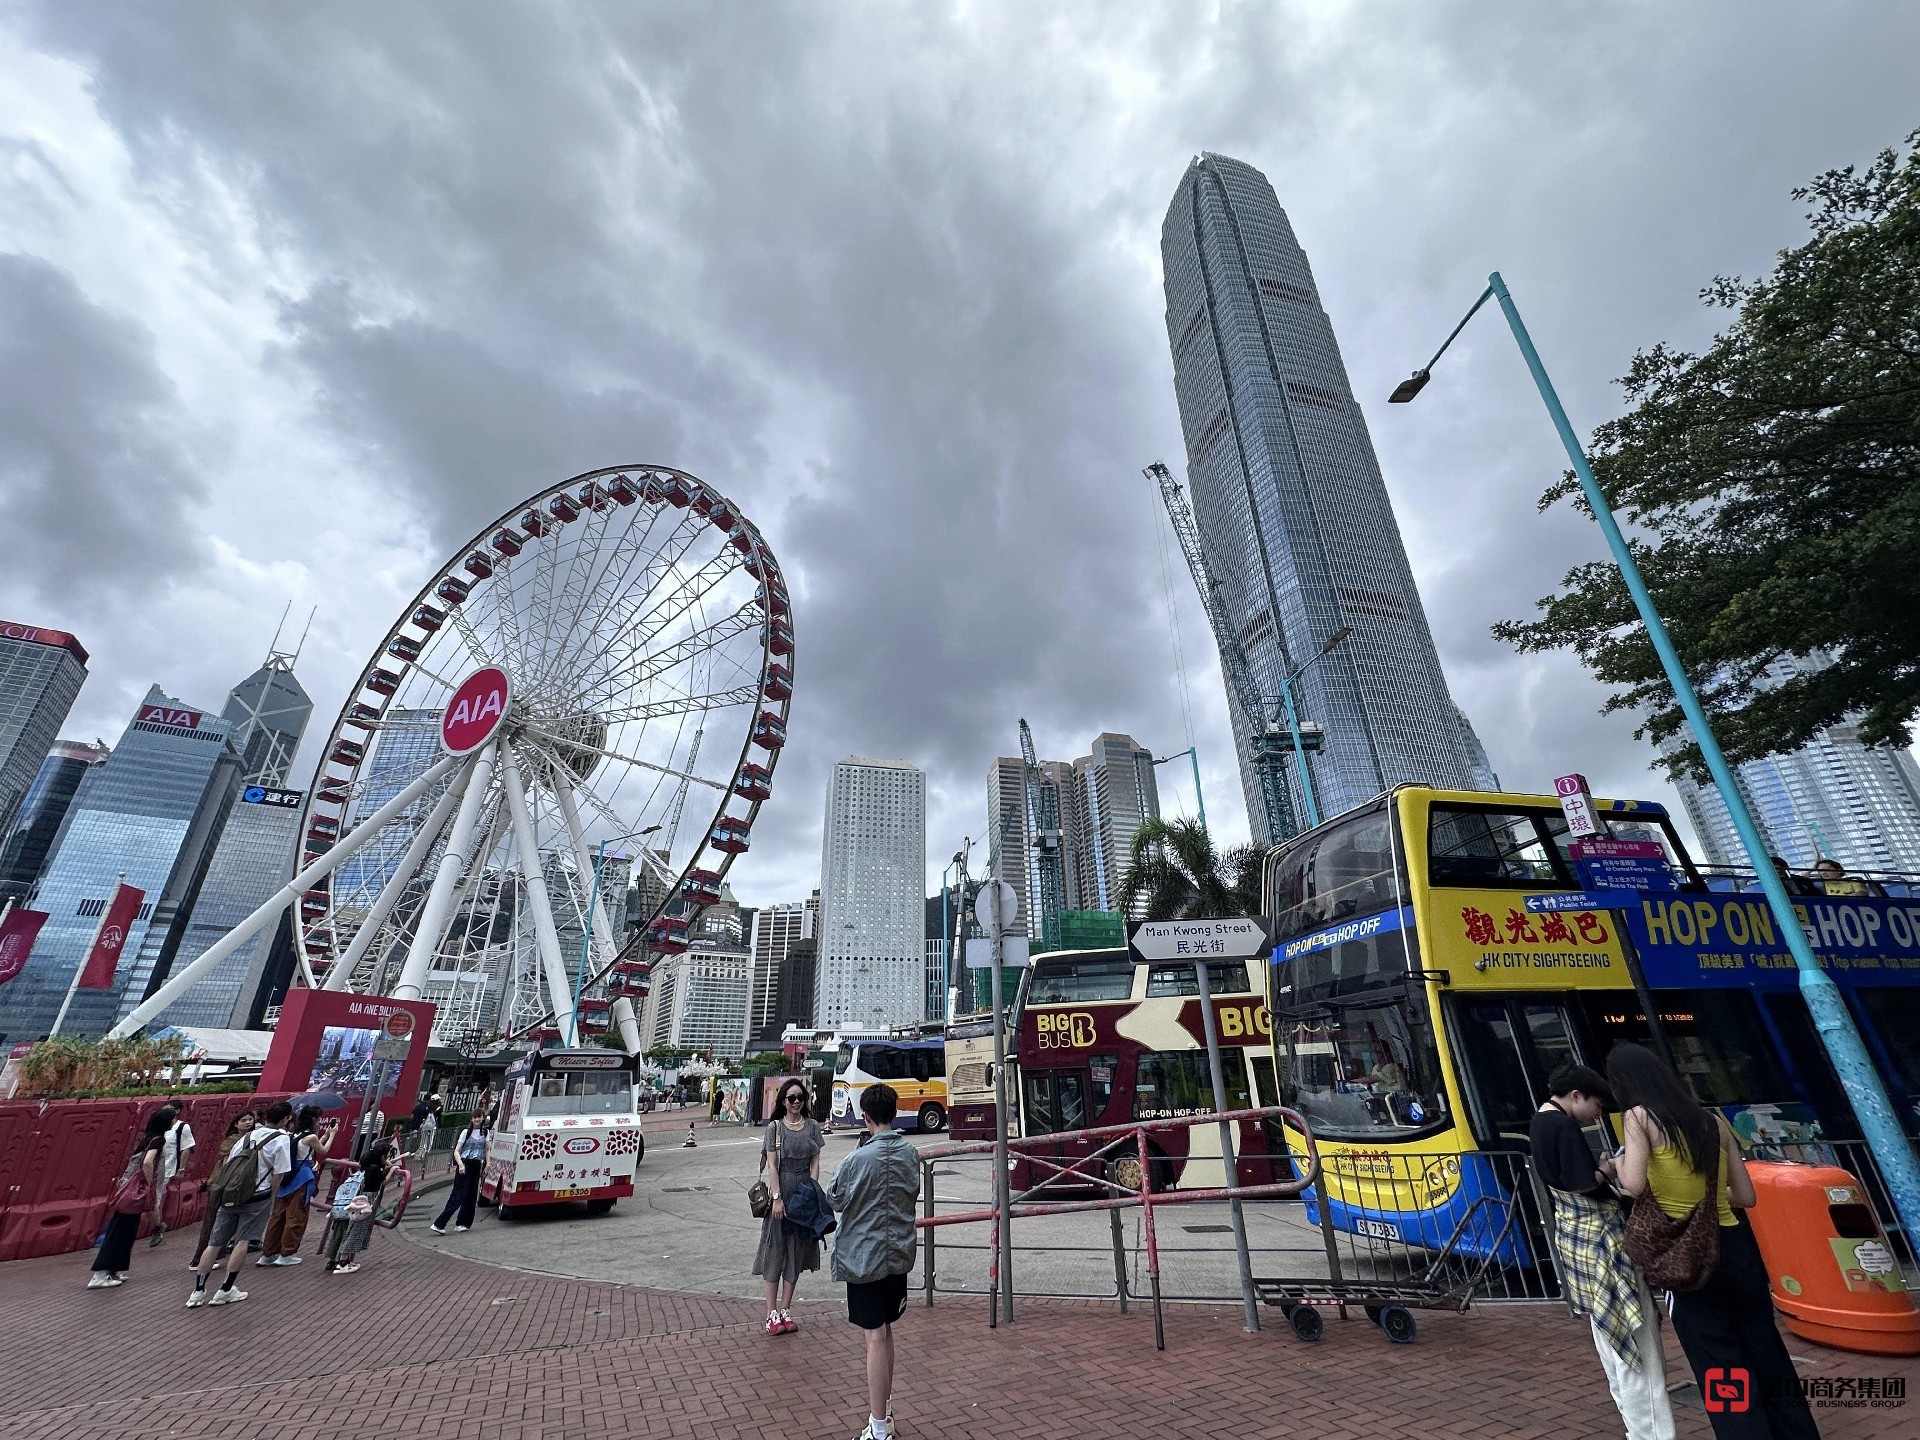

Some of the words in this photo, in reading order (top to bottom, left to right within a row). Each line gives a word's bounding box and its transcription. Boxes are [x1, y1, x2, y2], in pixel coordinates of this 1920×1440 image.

[145, 708, 191, 726] AIA
[447, 690, 500, 729] AIA
[265, 791, 300, 805] 建行
[1566, 799, 1591, 830] 中環
[1146, 927, 1169, 937] Man
[1173, 925, 1211, 937] Kwong
[1215, 923, 1252, 934] Street
[1338, 924, 1358, 941] HOP
[1360, 917, 1380, 935] OFF
[1461, 907, 1608, 946] 觀光城巴
[1643, 900, 1717, 945] HOP
[1723, 902, 1775, 945] ON
[1814, 905, 1880, 947] HOP
[1176, 939, 1224, 954] 民光街
[1285, 943, 1301, 958] HOP
[1482, 953, 1500, 967] HK
[1503, 953, 1530, 967] CITY
[1533, 953, 1610, 968] SIGHTSEEING
[349, 1003, 362, 1013] AIA
[1037, 1013, 1069, 1031] BIG
[1039, 1032, 1070, 1048] BUS
[558, 1056, 587, 1065] Mister
[589, 1057, 616, 1068] Softee
[1139, 1109, 1172, 1119] HOP-ON
[1173, 1107, 1211, 1117] HOP-OFF
